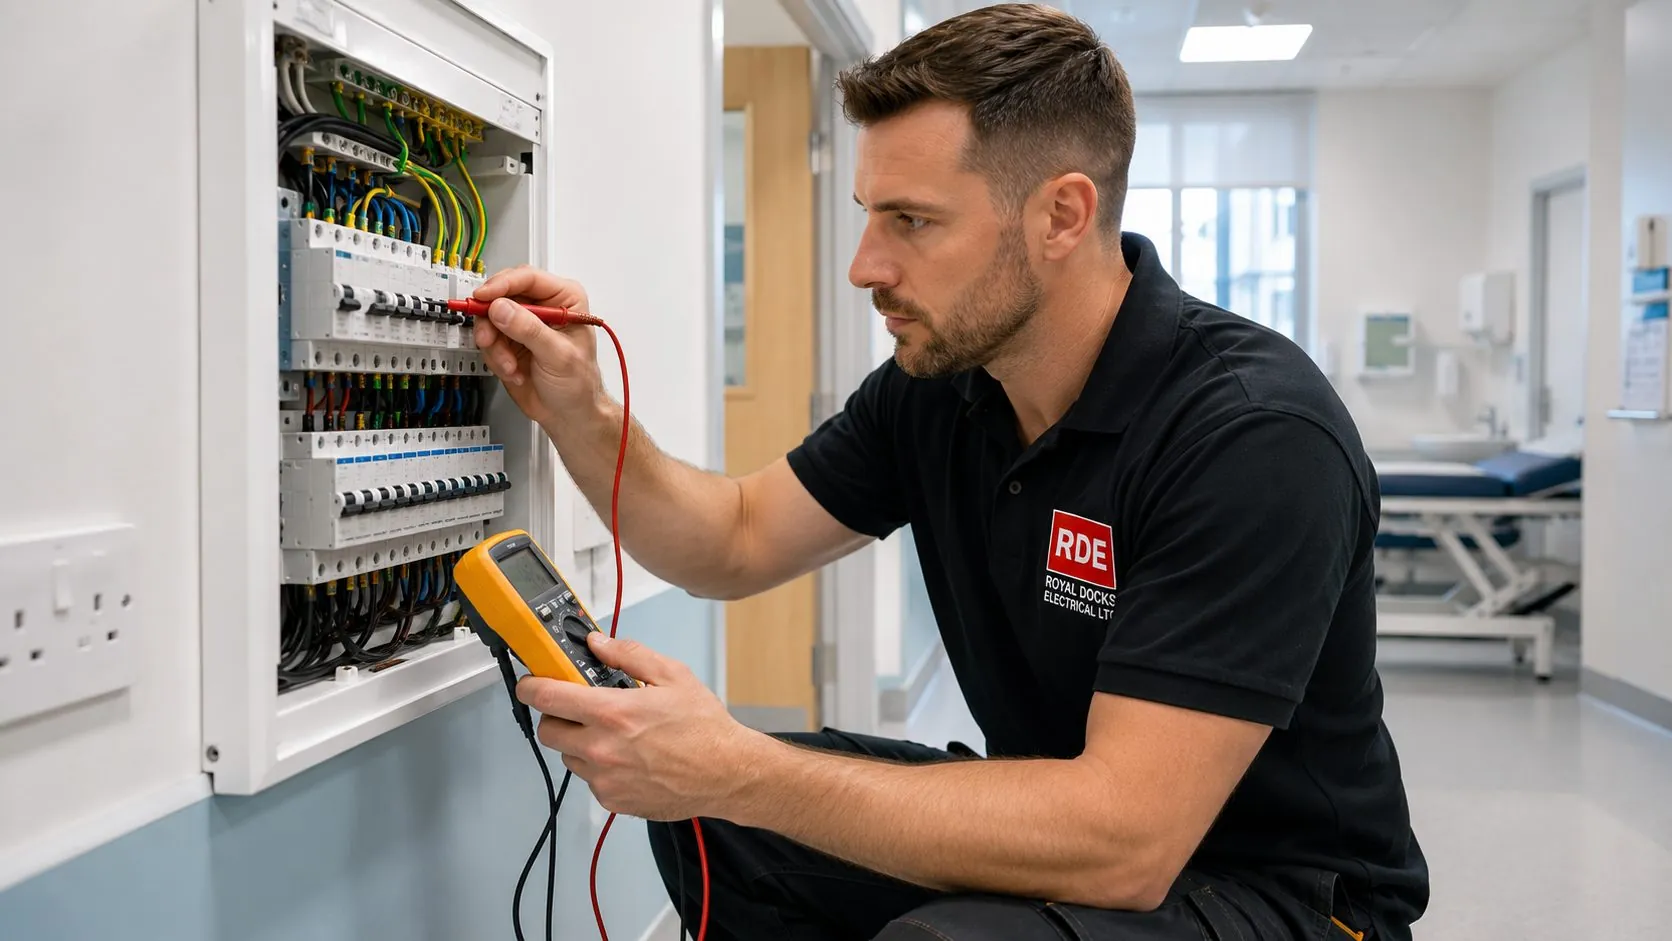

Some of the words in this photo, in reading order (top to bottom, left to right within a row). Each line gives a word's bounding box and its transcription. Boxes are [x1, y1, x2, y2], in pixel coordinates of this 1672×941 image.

[1055, 528, 1107, 571] RDE
[1044, 590, 1096, 617] ELECTRICAL
[1045, 575, 1077, 596] ROYAL
[1080, 586, 1116, 607] DOCKS
